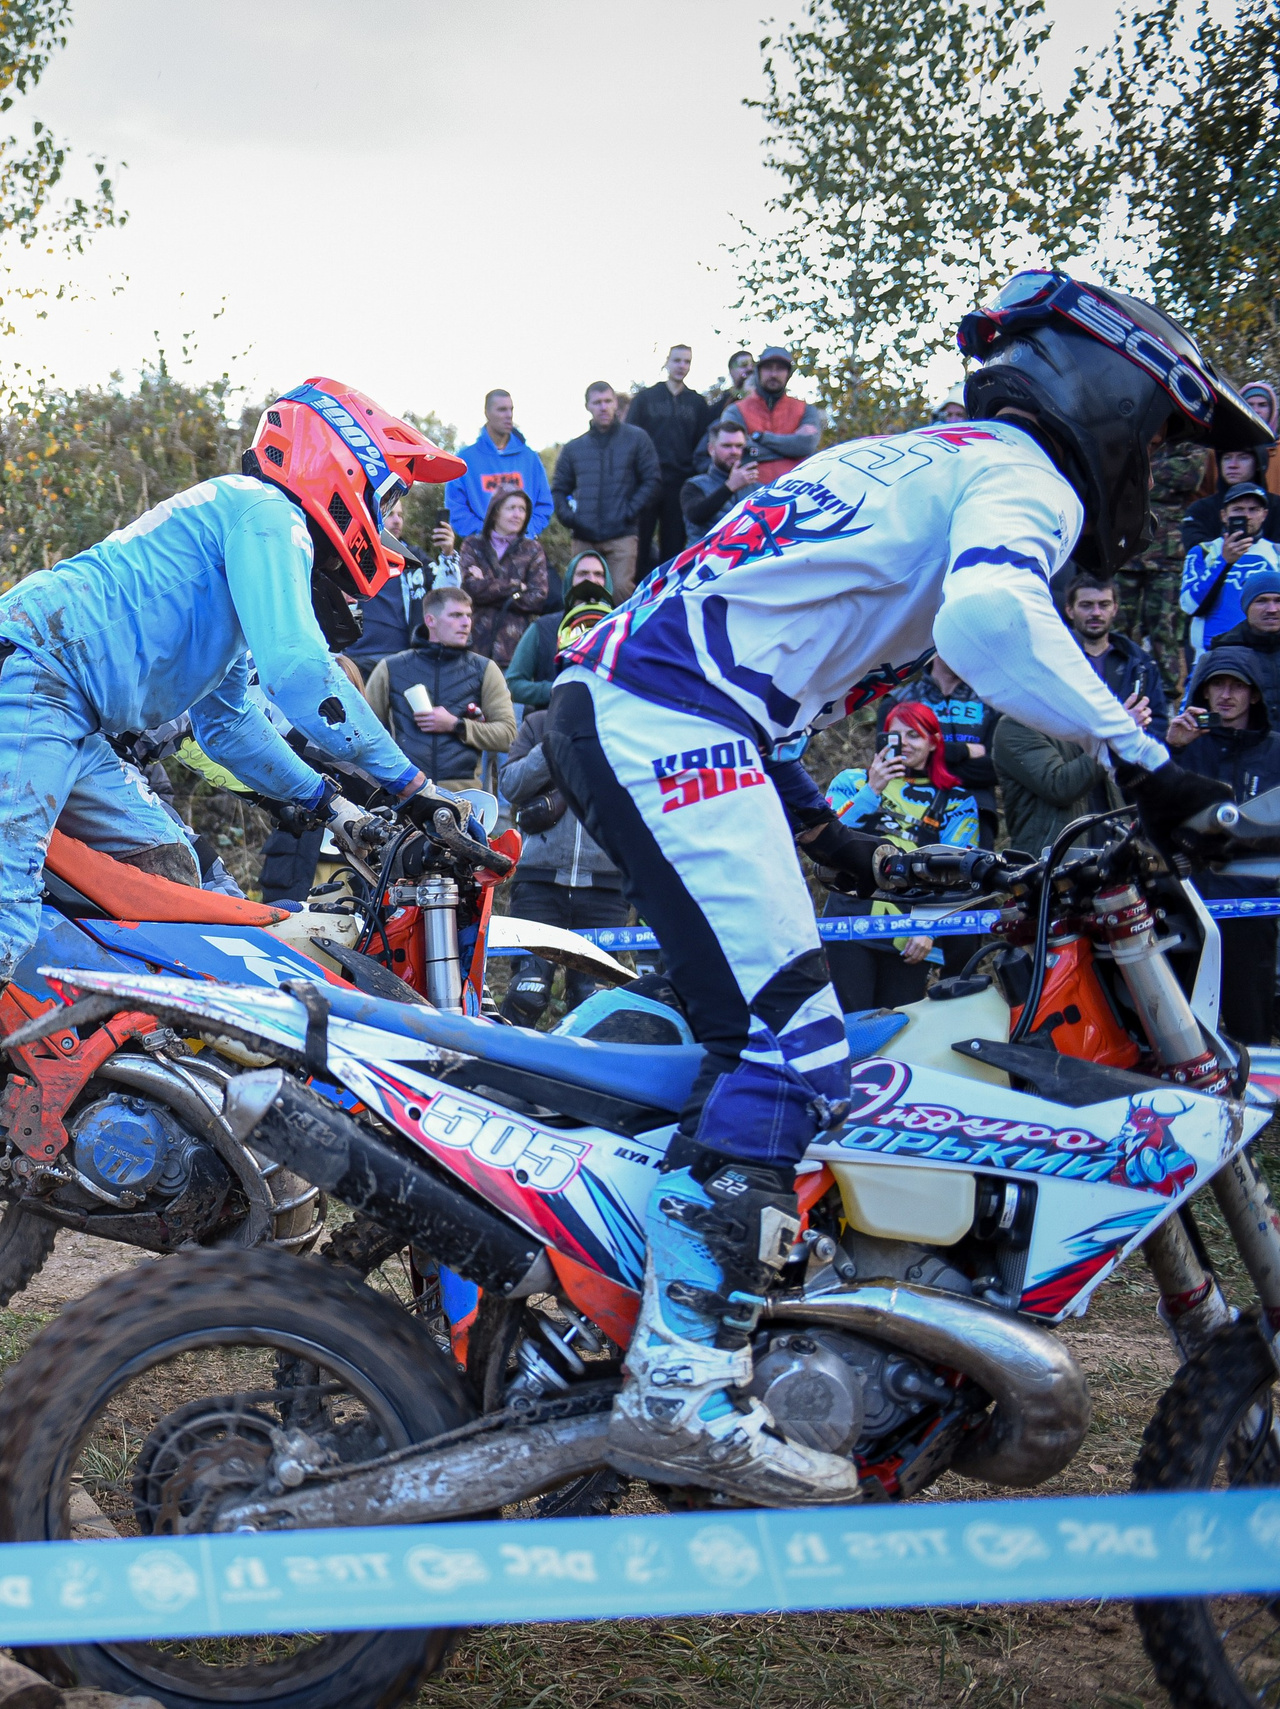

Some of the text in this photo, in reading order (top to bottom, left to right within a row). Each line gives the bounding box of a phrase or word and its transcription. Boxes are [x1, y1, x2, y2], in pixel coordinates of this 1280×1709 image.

[1068, 295, 1213, 422] SCO
[310, 396, 386, 477] 100%
[652, 739, 753, 778] KROL
[890, 919, 912, 930] DRC
[422, 1093, 587, 1191] 505
[614, 1147, 650, 1165] ILYA
[712, 1177, 748, 1196] 22
[724, 1170, 748, 1183] SG
